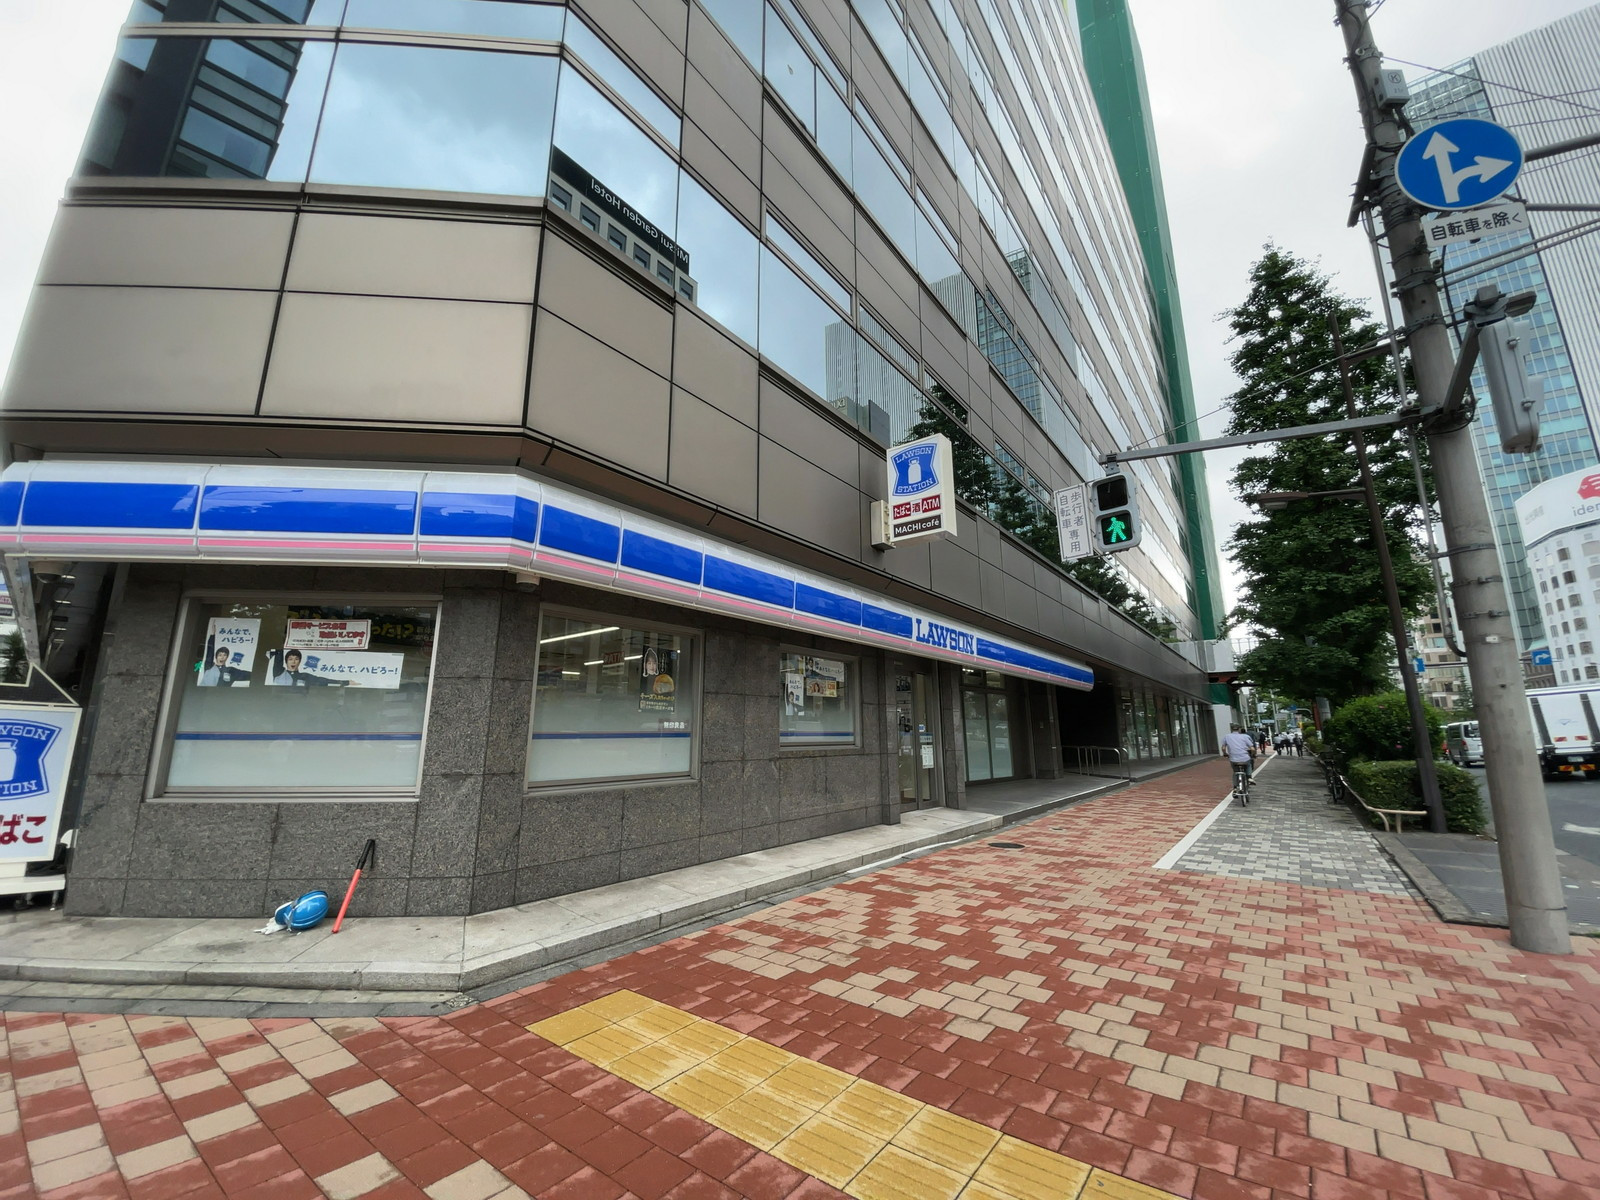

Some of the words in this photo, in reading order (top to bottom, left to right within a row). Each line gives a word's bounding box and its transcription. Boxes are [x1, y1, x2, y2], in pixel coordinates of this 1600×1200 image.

[1431, 210, 1523, 241] 自転車を除く
[895, 447, 932, 464] LAWSON
[897, 478, 934, 493] STATION
[894, 504, 911, 518] たばこ
[922, 497, 940, 511] ATM
[1059, 495, 1072, 529] 自転車
[1070, 491, 1084, 527] 歩行者
[895, 522, 921, 536] MACHI
[921, 518, 940, 530] café
[1068, 529, 1081, 553] 専用
[219, 627, 251, 636] みんなで、
[915, 617, 975, 655] LAWSON
[0, 780, 38, 795] ION
[0, 813, 47, 846] ばこ
